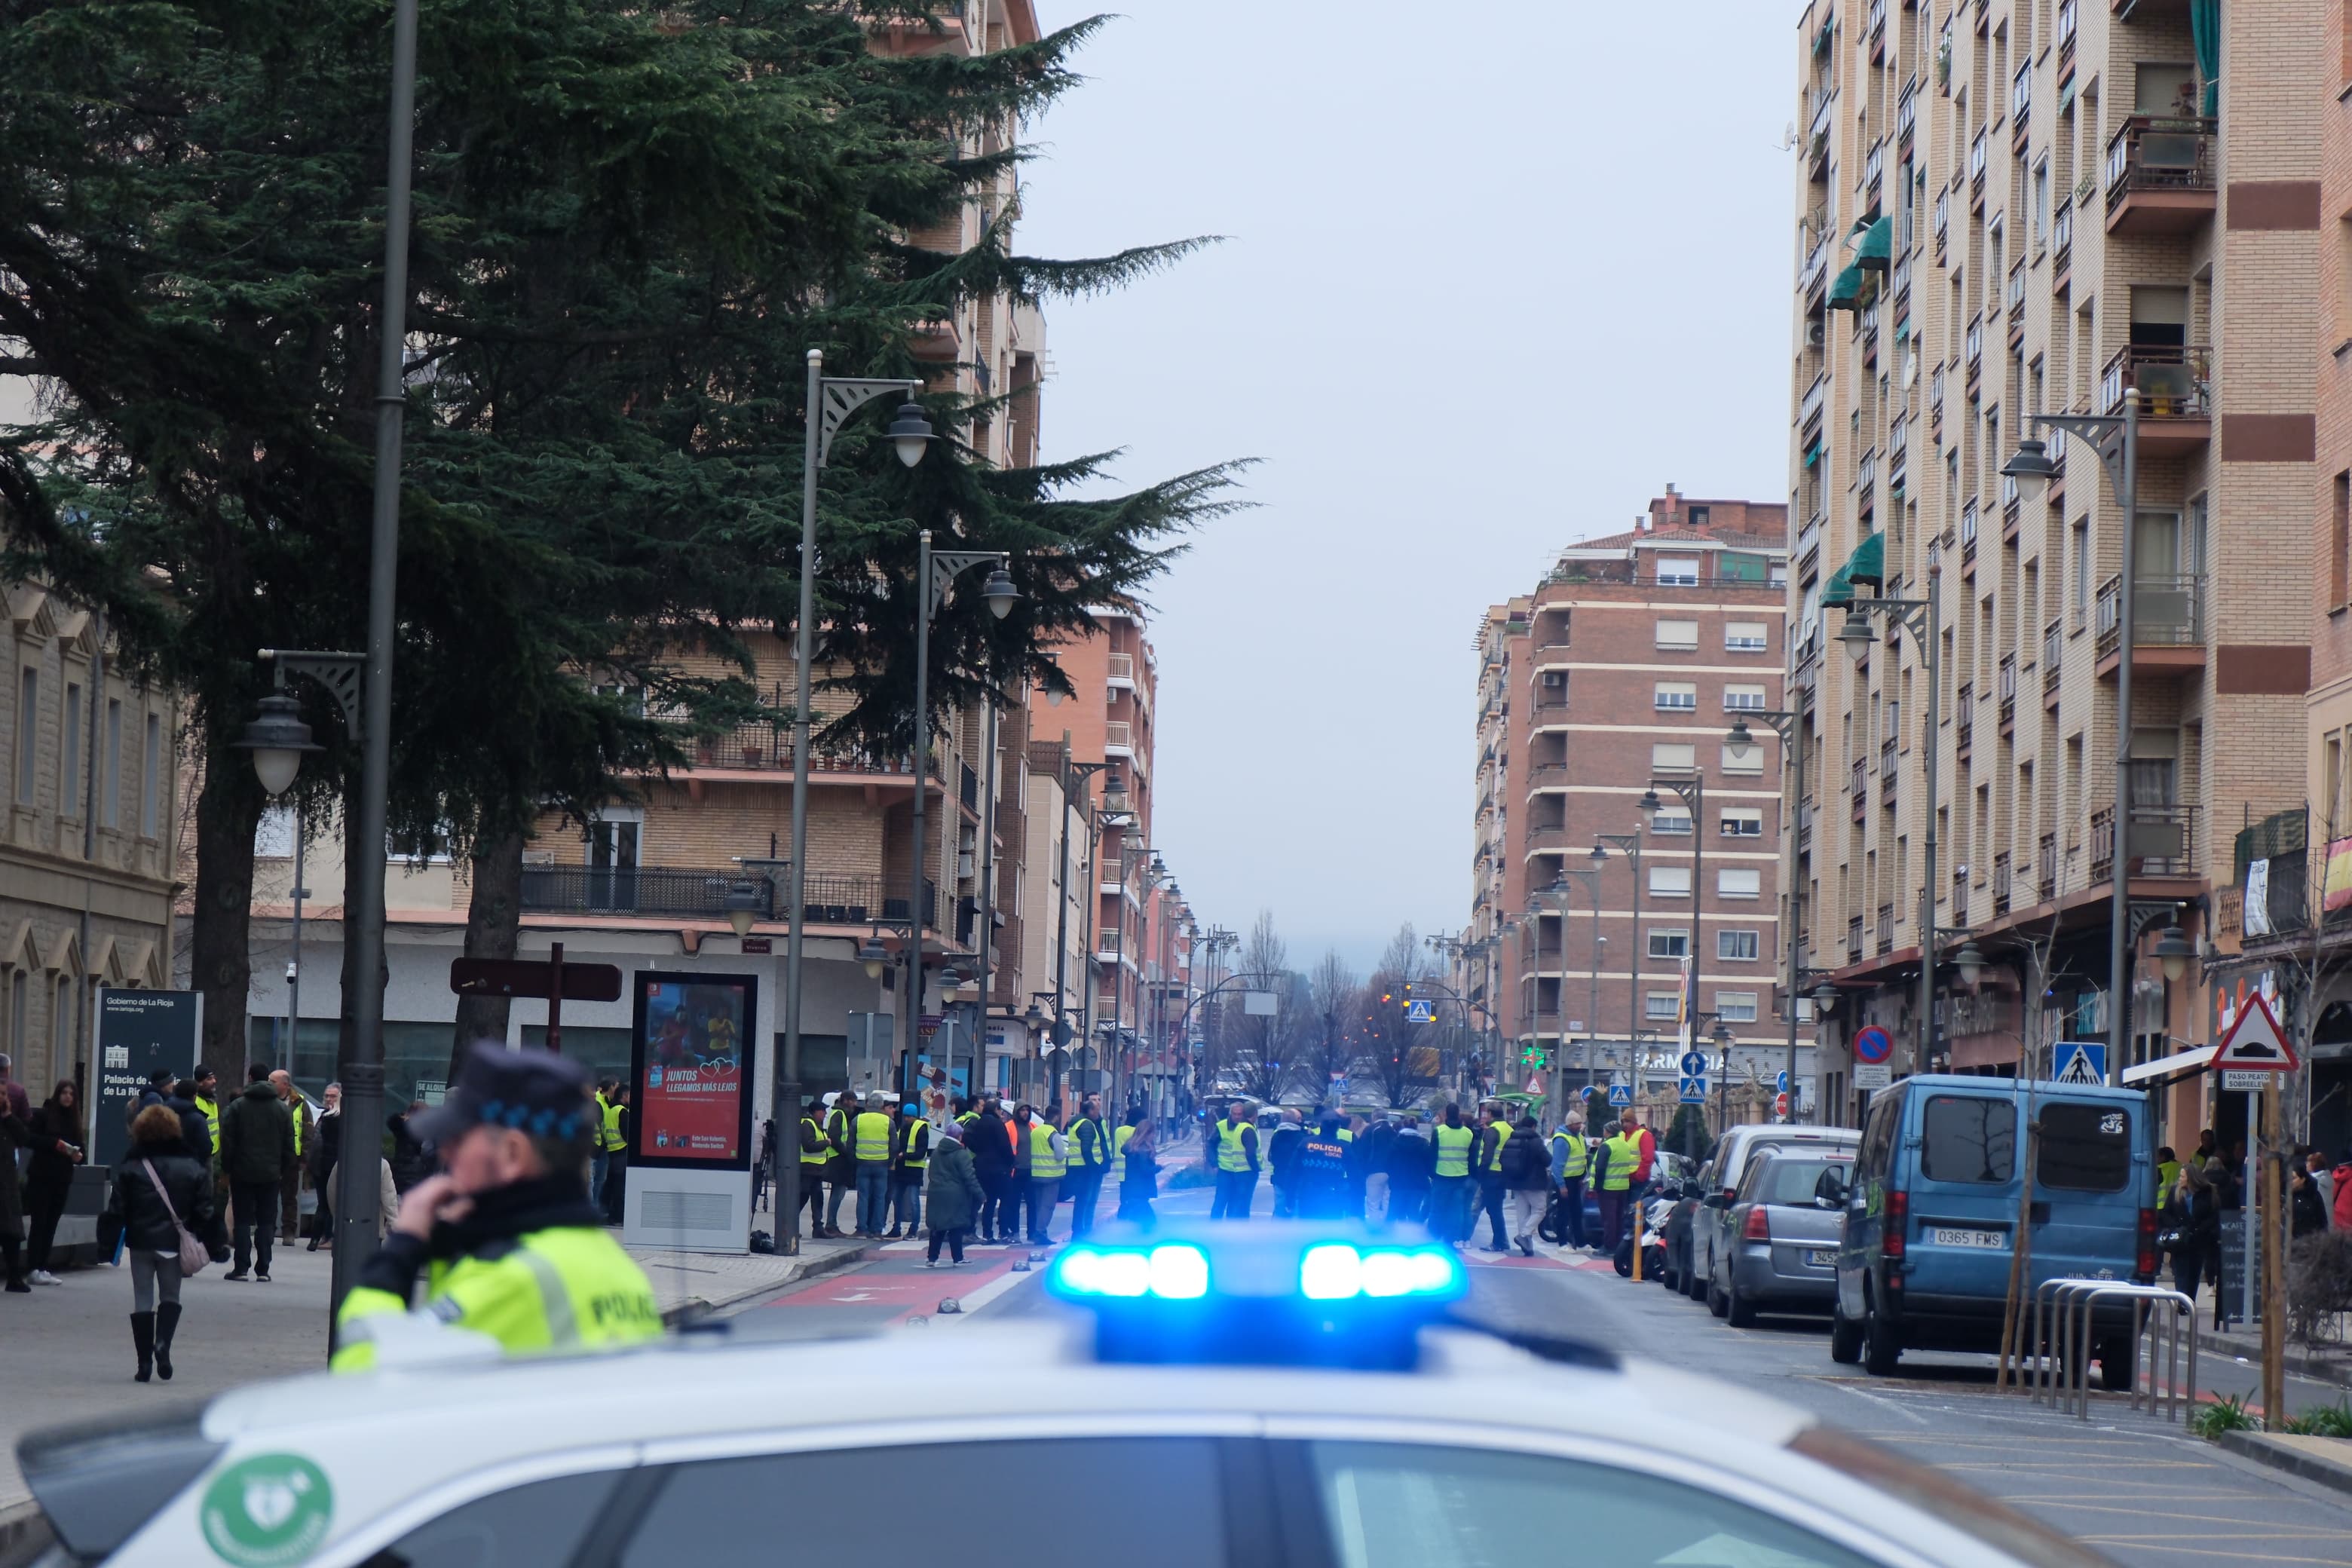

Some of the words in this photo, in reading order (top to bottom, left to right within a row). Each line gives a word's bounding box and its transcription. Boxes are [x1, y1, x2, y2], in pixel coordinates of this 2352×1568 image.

[106, 997, 138, 1006] Gobierno
[157, 999, 174, 1007] Rioja
[1634, 1053, 1729, 1070] ARMIA
[104, 1074, 134, 1085] Palacio
[136, 1076, 147, 1085] de
[666, 1070, 698, 1081] JUNTOS
[104, 1086, 114, 1095] de
[116, 1087, 127, 1096] La
[666, 1084, 701, 1092] LLEGAMOS
[702, 1082, 717, 1092] MÁS
[718, 1083, 737, 1092] LEJOS
[1307, 1143, 1342, 1153] POLICIA
[1939, 1230, 1970, 1245] 0365
[1976, 1233, 2000, 1246] FMS
[590, 1292, 660, 1325] POLIC
